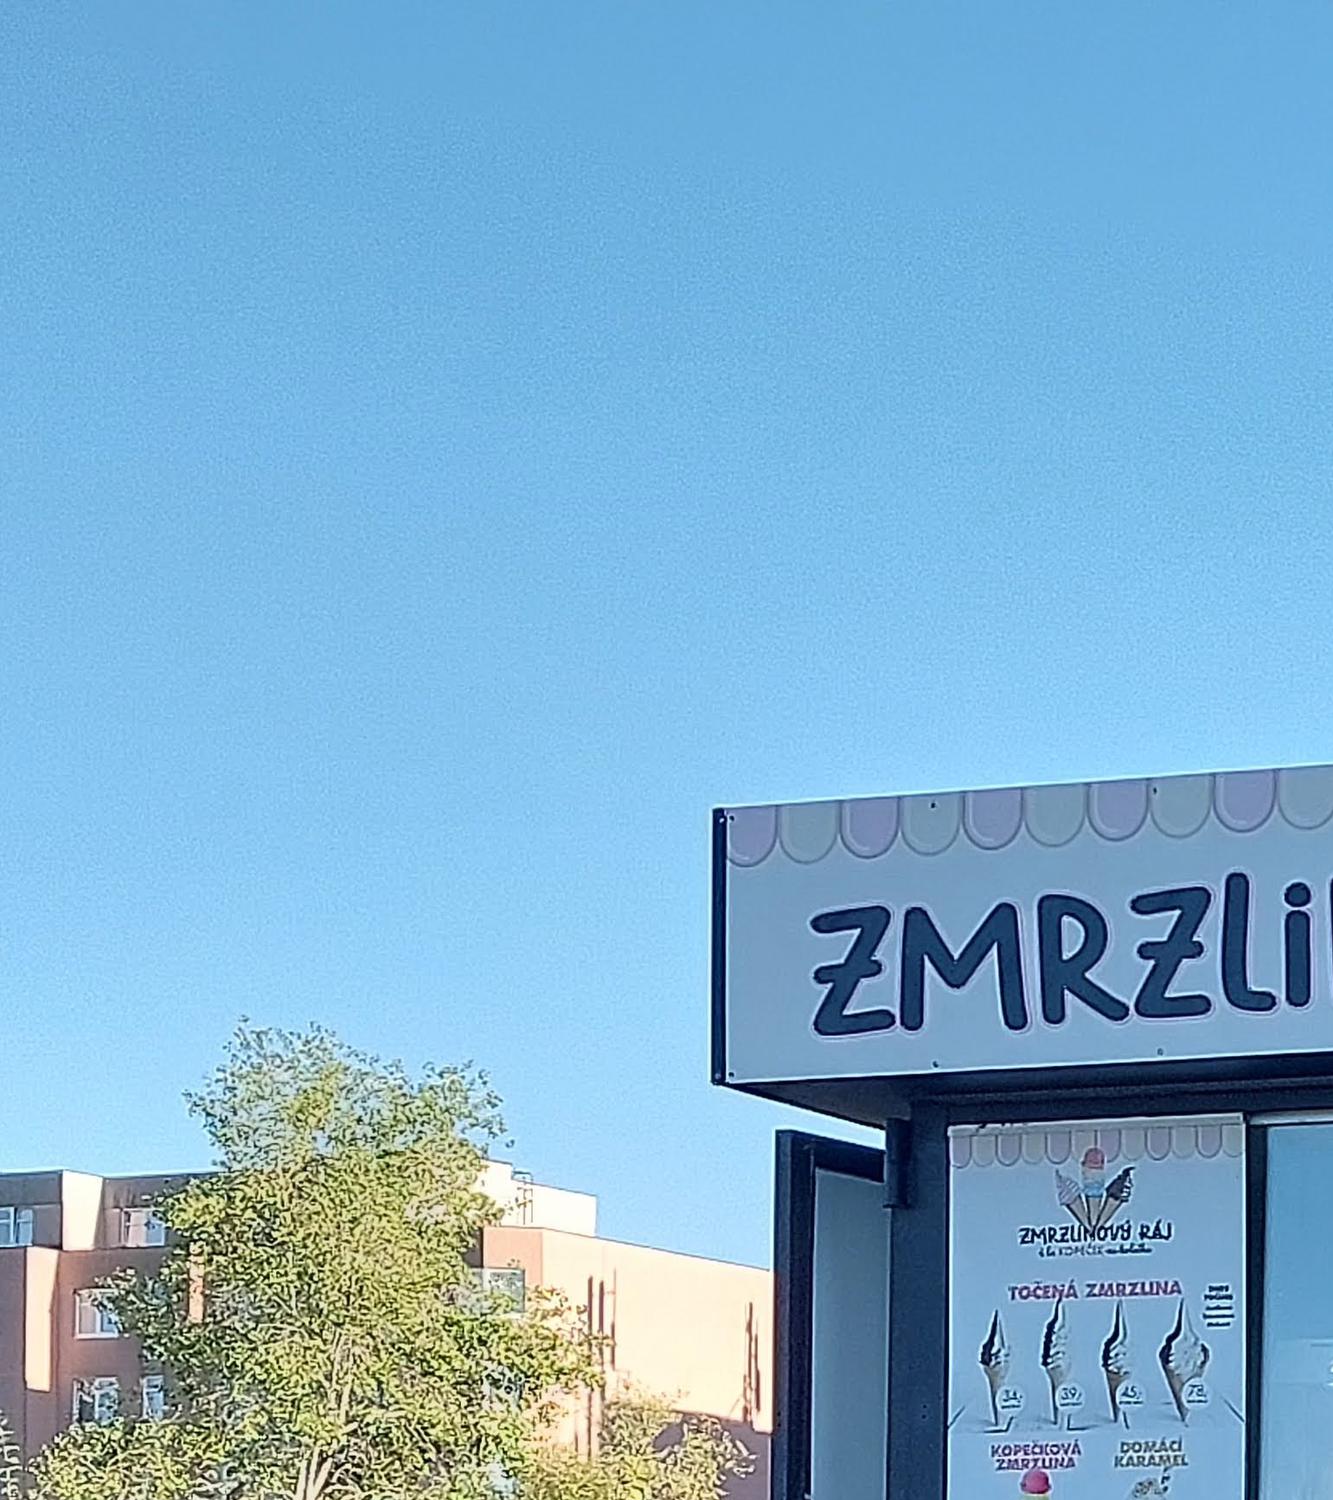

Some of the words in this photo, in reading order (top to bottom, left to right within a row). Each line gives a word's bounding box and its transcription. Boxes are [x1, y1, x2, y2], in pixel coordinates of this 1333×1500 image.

[1138, 1219, 1172, 1241] RÁJ
[1008, 1278, 1079, 1300] TOČENÁ
[1086, 1280, 1183, 1298] ZMRZLINA
[991, 1438, 1082, 1458] KOPEČKOVÁ
[1120, 1435, 1183, 1454] DOMÁCÍ
[995, 1456, 1076, 1471] ZMRZLINA
[1114, 1453, 1189, 1468] KARAMEL
